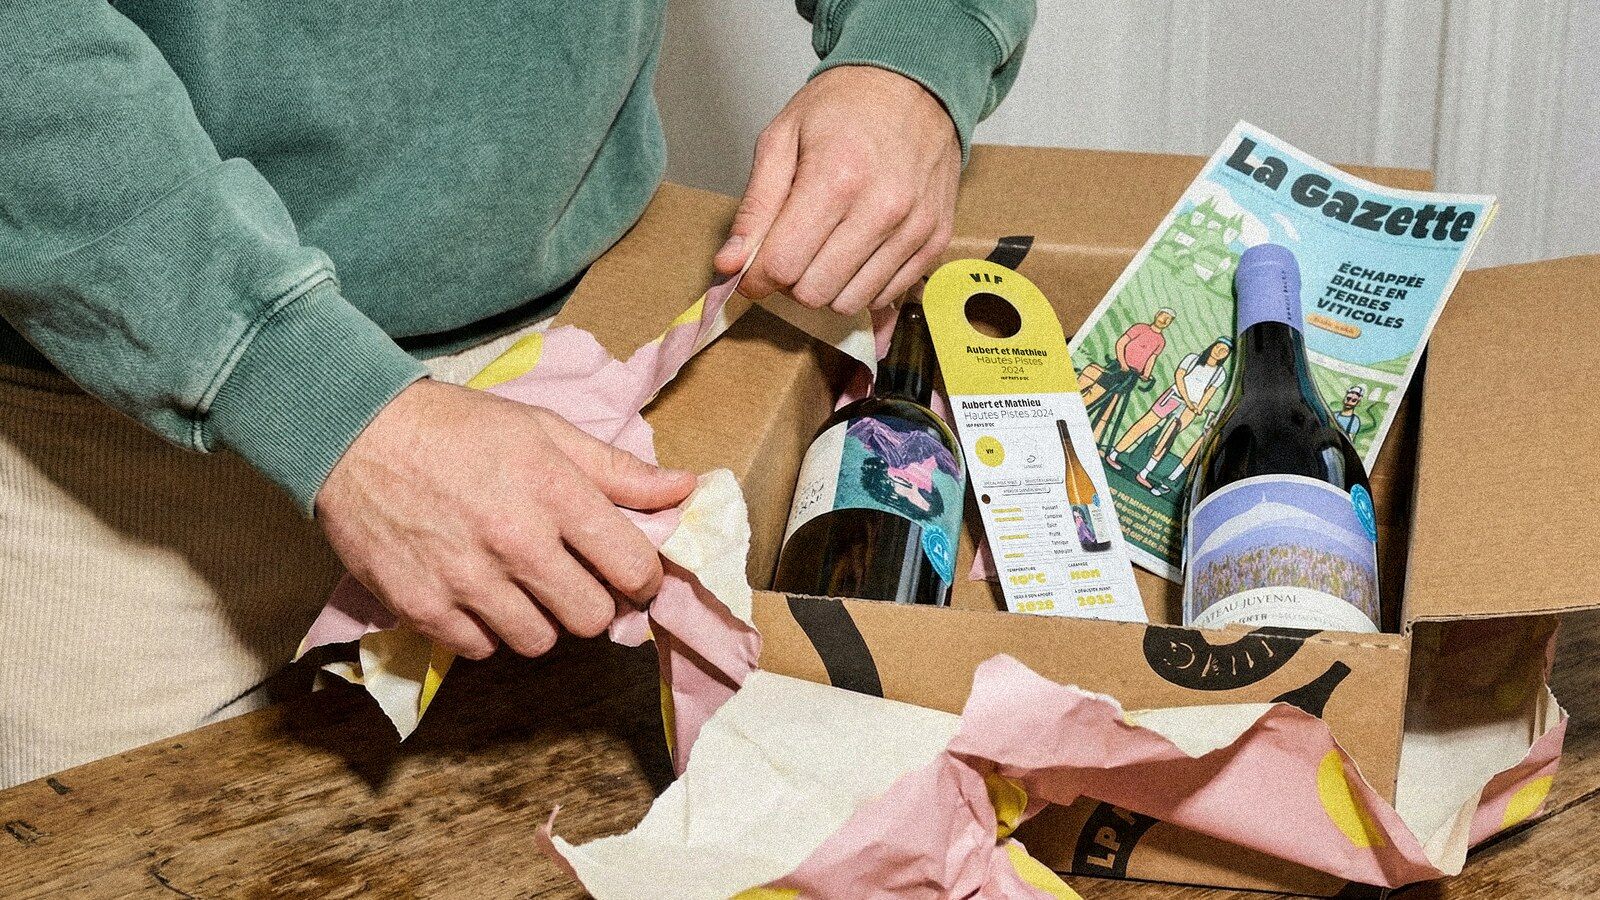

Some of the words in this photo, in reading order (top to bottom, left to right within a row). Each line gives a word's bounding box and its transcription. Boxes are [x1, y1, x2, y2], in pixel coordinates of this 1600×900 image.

[1225, 137, 1289, 191] La
[1290, 173, 1476, 242] Gazette
[1338, 261, 1425, 288] ÉCHAPPÉE
[1330, 274, 1386, 297] BALLE
[1385, 287, 1408, 300] EN
[1317, 297, 1405, 329] VITICOLES
[966, 346, 1000, 355] Aubert
[1000, 347, 1011, 355] et
[1012, 348, 1047, 357] Mathieu
[976, 356, 1013, 365] Hautes
[1015, 356, 1043, 366] Pistes
[1001, 366, 1025, 374] 2024
[961, 400, 993, 410] Aubert
[993, 400, 1004, 409] et
[1004, 398, 1041, 408] Mathieu
[963, 410, 999, 421] Hautes
[1000, 409, 1030, 419] Pistes
[1032, 408, 1054, 418] 2024
[1242, 594, 1299, 609] JUVENAL
